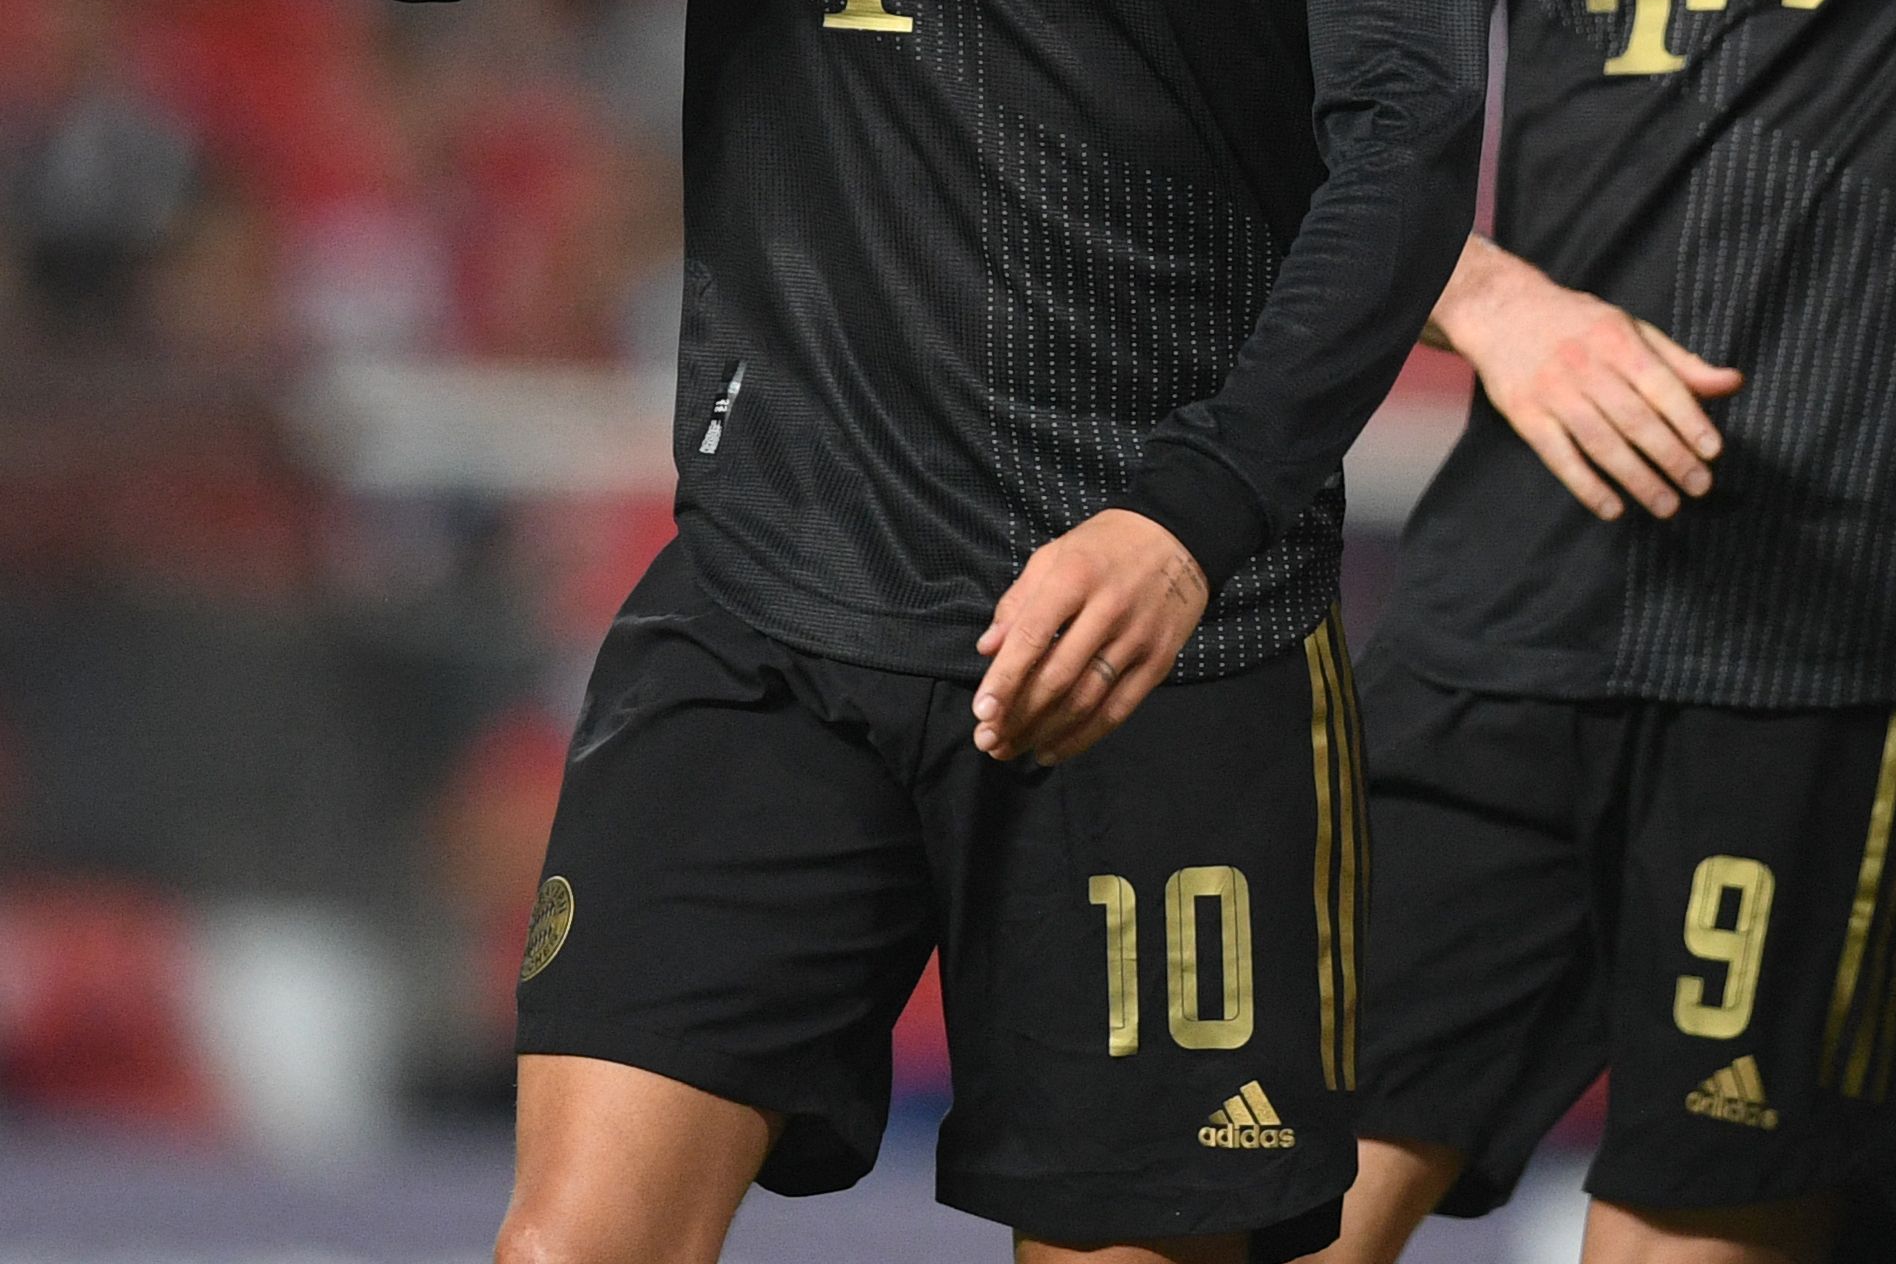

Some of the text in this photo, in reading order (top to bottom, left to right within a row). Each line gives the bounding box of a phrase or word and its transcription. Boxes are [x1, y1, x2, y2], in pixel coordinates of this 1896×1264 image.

[1088, 865, 1254, 1058] 10
[1673, 854, 1776, 1040] 9
[1197, 1123, 1296, 1149] adidas
[1684, 1091, 1779, 1130] adidas
